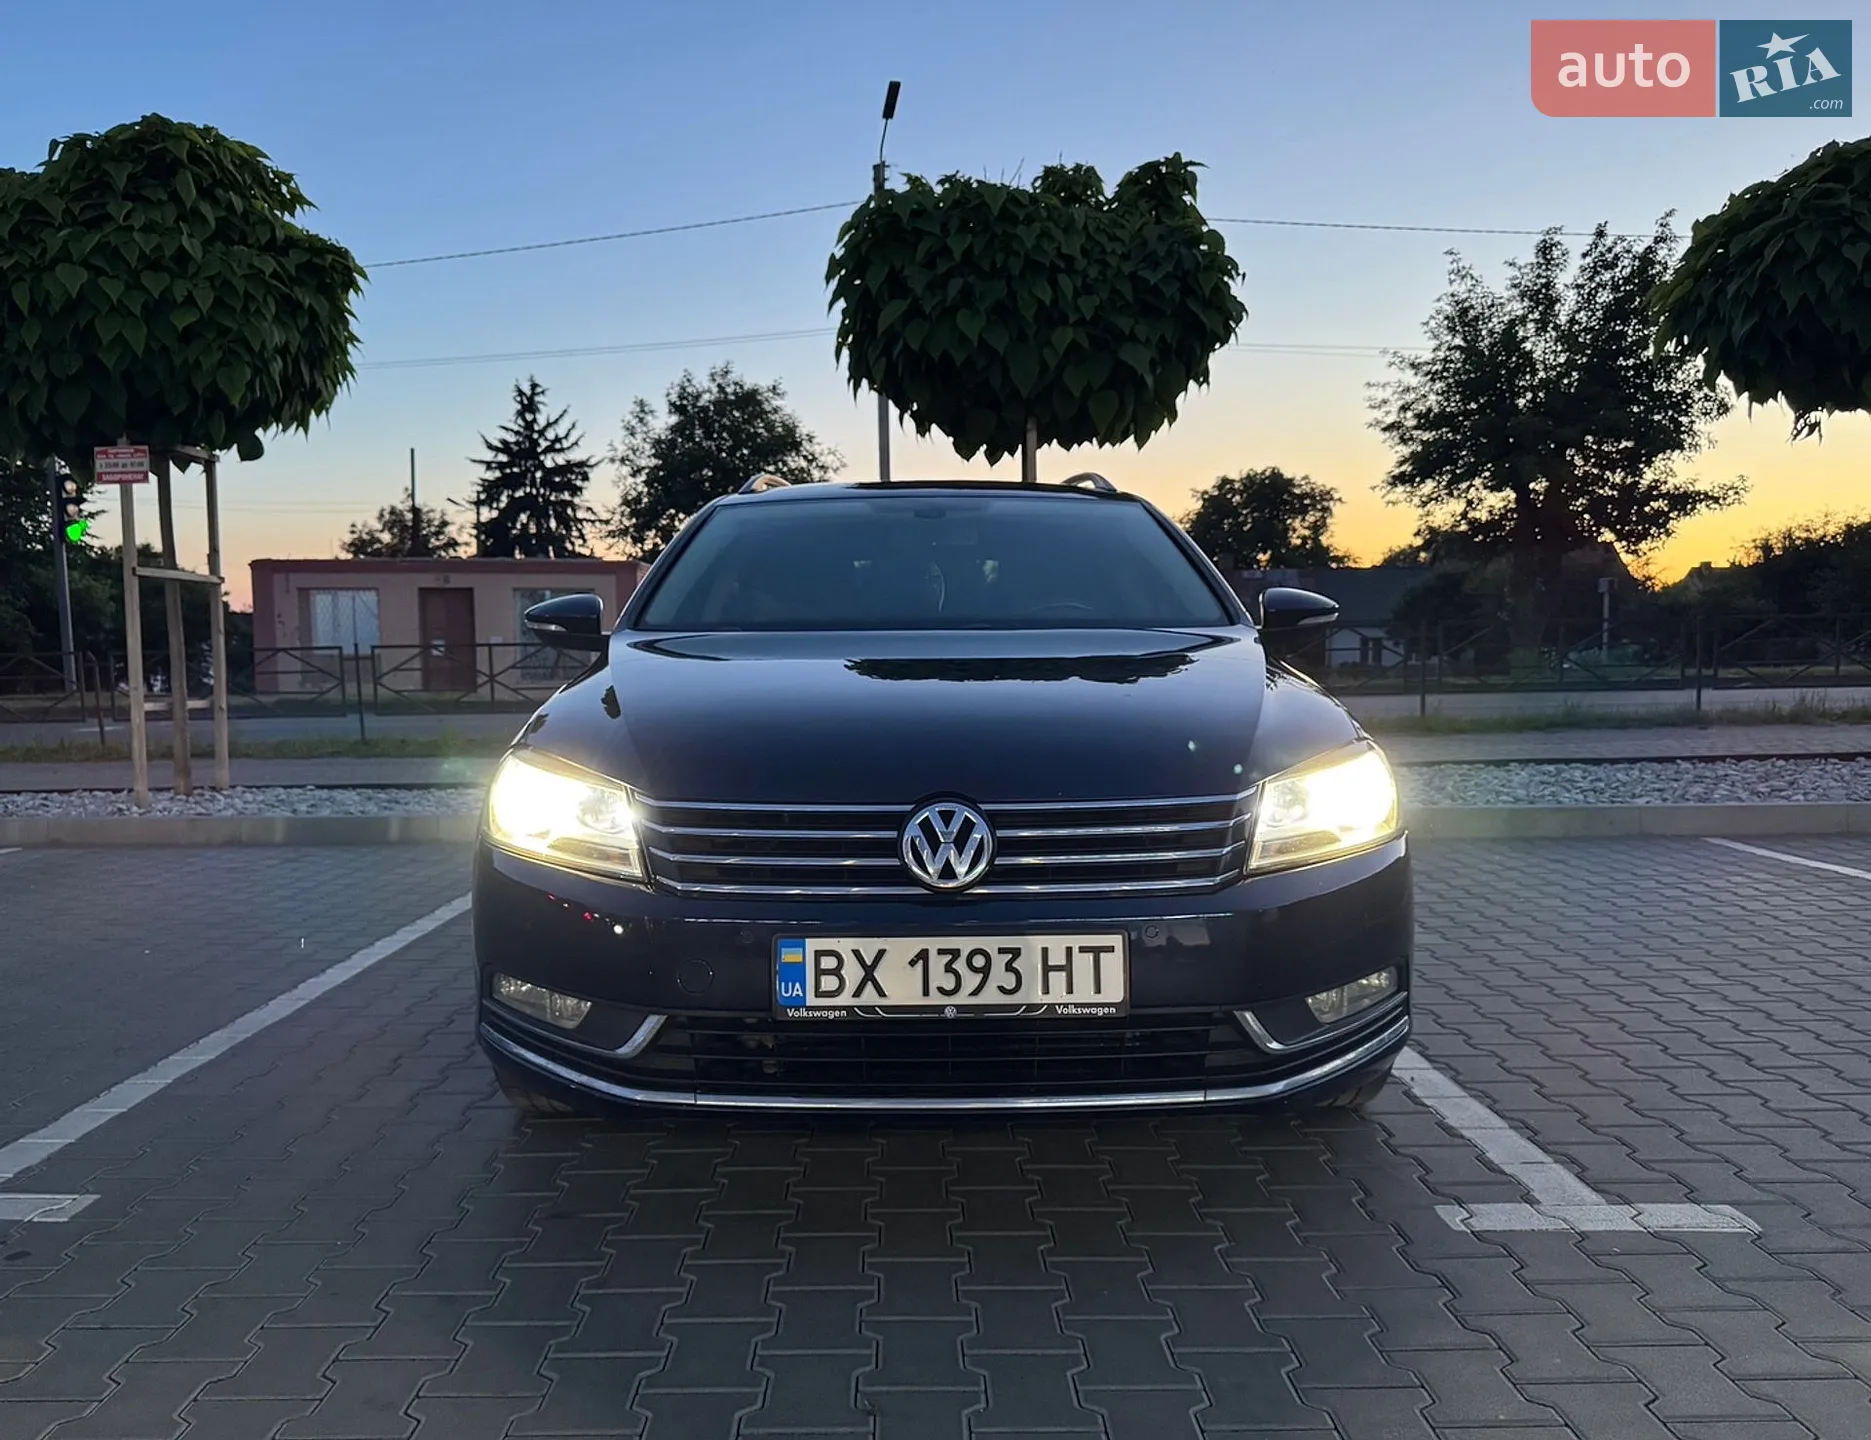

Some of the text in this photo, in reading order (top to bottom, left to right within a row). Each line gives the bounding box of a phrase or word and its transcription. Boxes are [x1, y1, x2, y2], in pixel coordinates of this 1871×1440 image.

[903, 802, 992, 888] VW
[814, 945, 1115, 999] BX 1393 HT
[782, 982, 804, 999] UA
[786, 1007, 847, 1019] Volkswagen
[1055, 1004, 1117, 1016] Volkswagen
